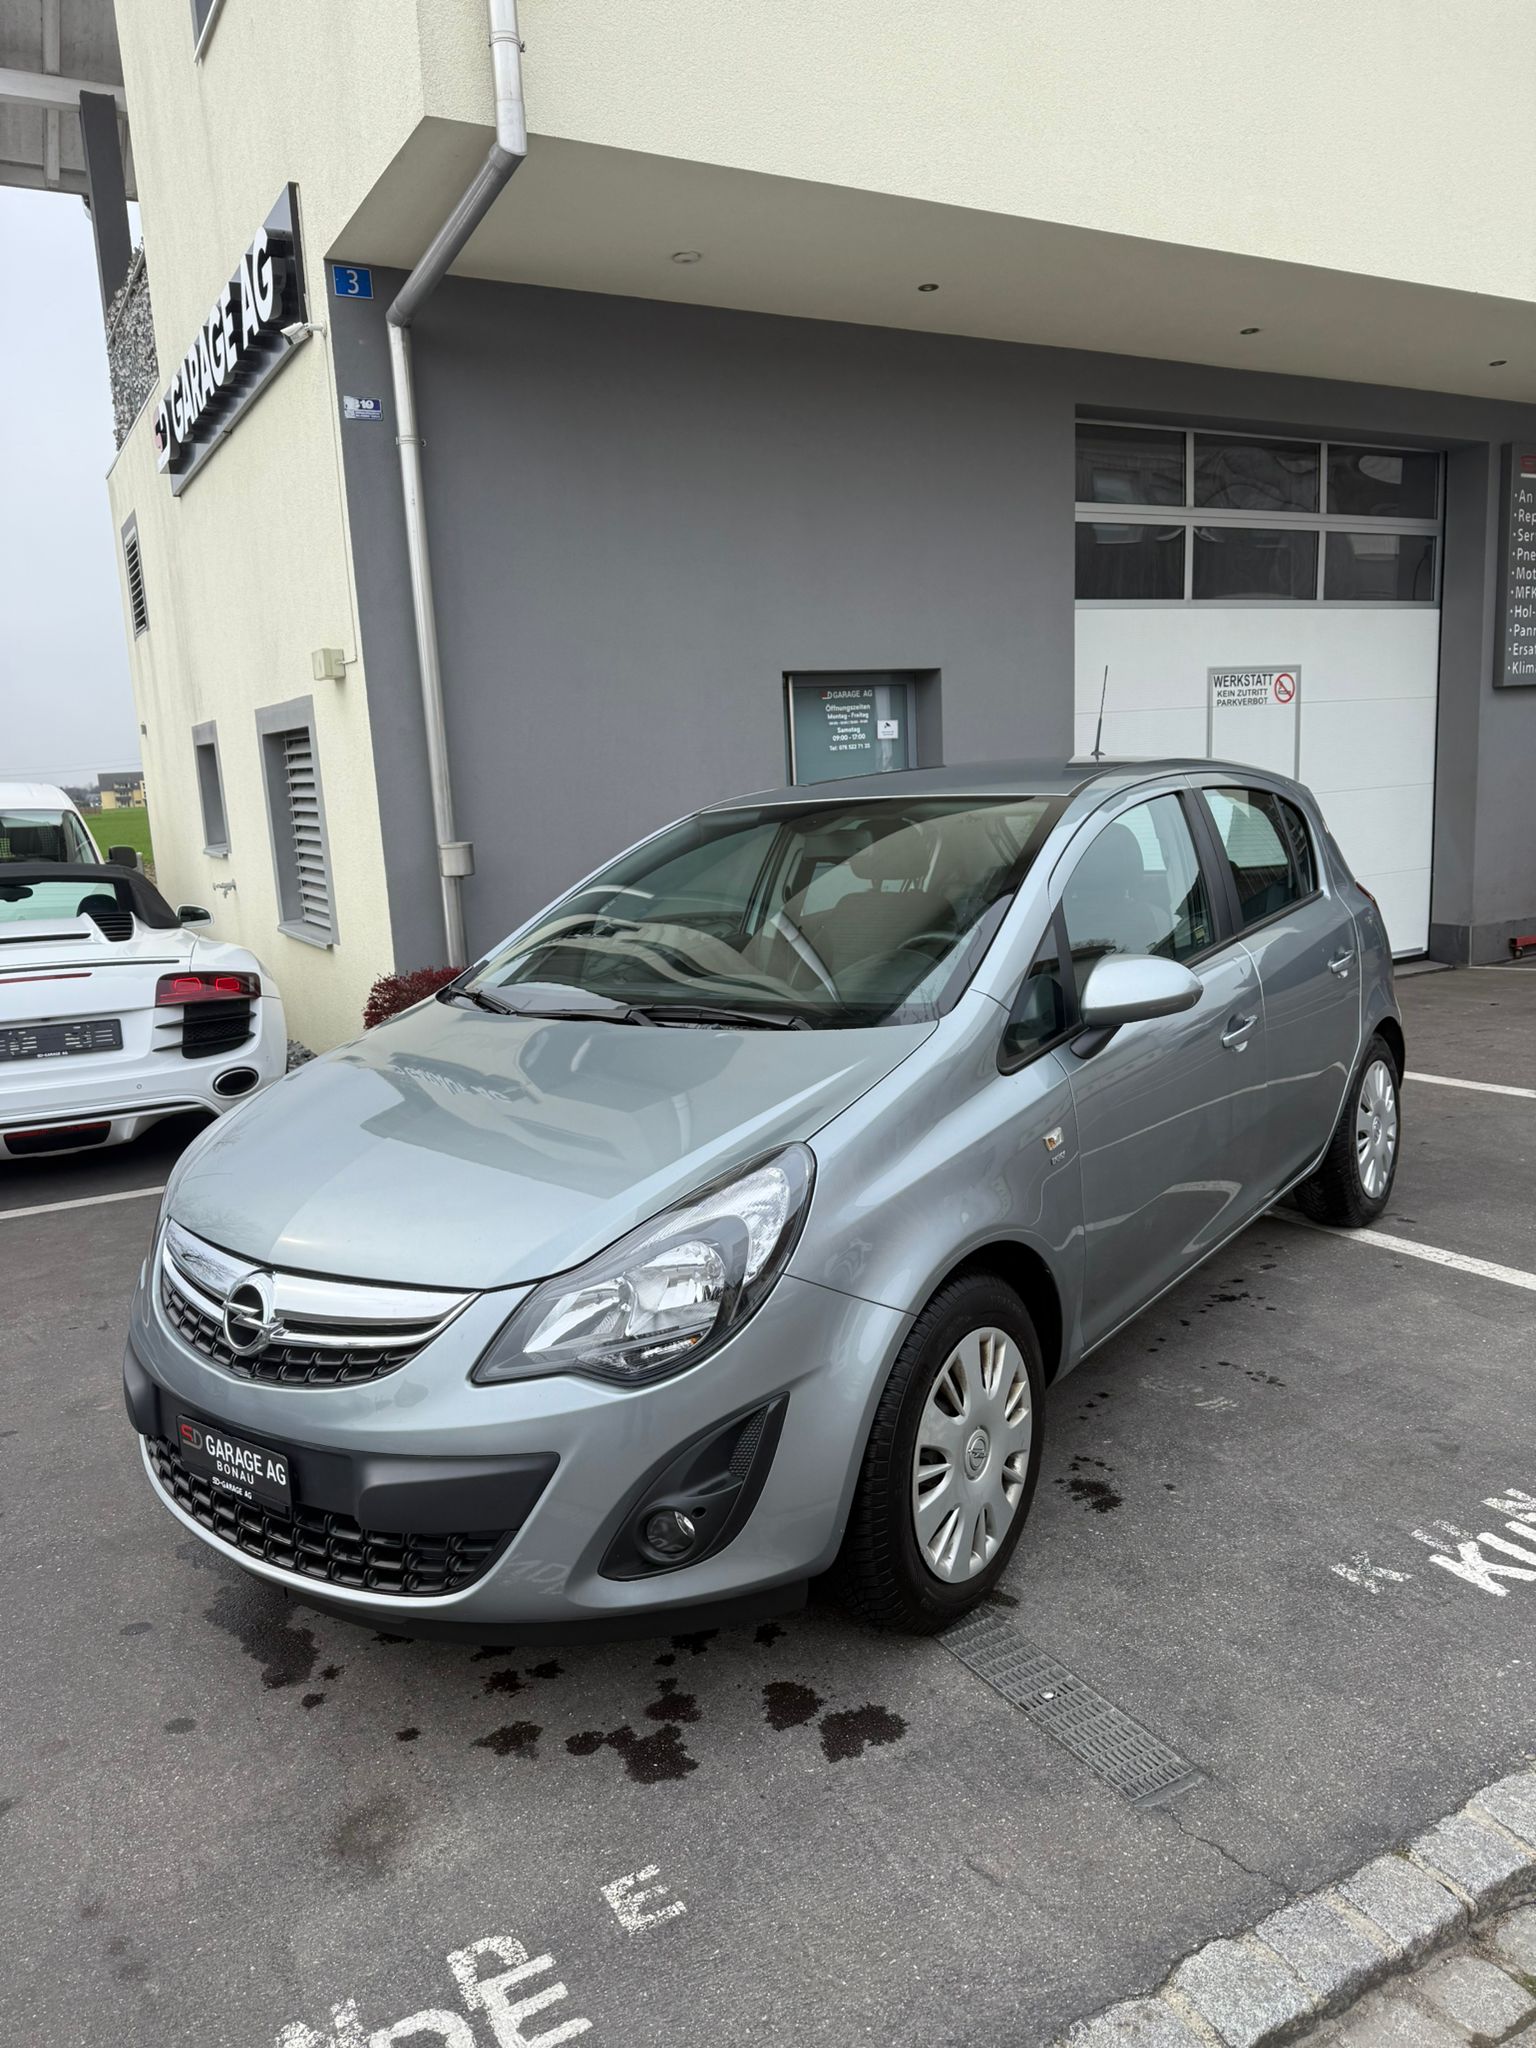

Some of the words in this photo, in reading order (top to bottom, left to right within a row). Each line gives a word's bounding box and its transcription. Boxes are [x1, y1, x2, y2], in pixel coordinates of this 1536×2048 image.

[346, 269, 360, 294] 3
[170, 281, 238, 444] GARAGE
[240, 226, 274, 350] AG
[1512, 660, 1536, 674] Klim
[1213, 673, 1274, 688] WERKSTATT
[833, 690, 860, 699] GARAGE
[863, 689, 873, 697] AG
[1217, 689, 1236, 698] KEIN
[1237, 688, 1269, 697] ZUTRITT
[1216, 697, 1269, 707] PARKVERBOT
[205, 1434, 264, 1476] GARAGE
[266, 1459, 287, 1486] AG
[216, 1460, 255, 1485] BONAU
